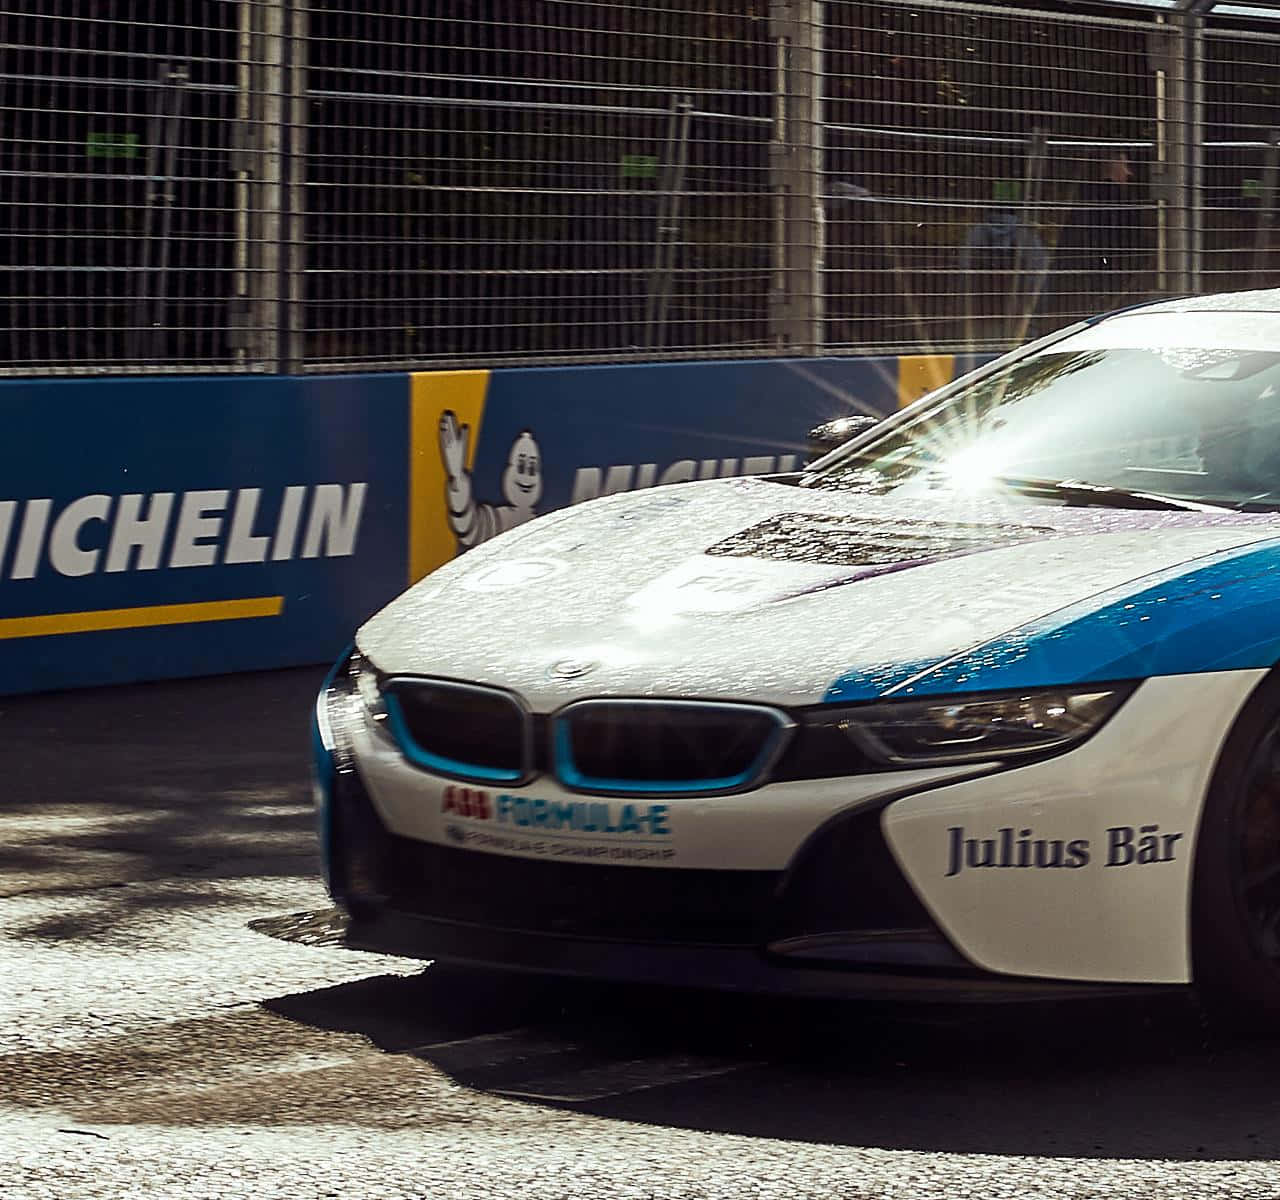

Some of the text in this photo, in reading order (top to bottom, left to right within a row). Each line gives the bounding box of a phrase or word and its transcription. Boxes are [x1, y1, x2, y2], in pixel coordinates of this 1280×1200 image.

[0, 482, 368, 580] ICHELIN
[441, 785, 492, 821] ABB
[944, 823, 1183, 878] Julius Bär
